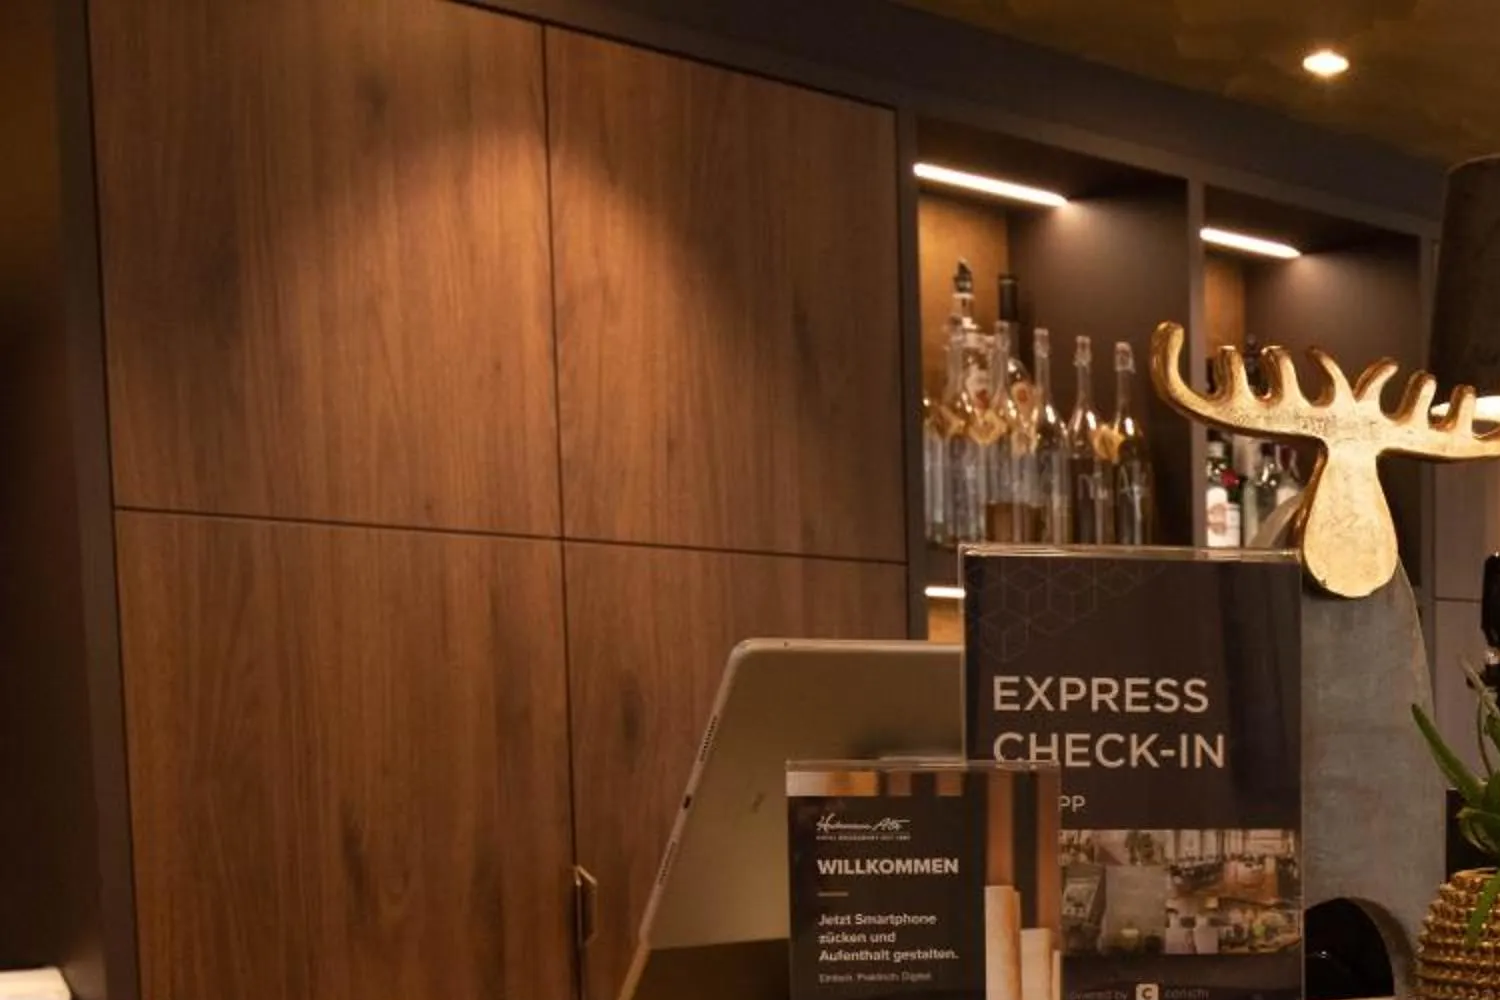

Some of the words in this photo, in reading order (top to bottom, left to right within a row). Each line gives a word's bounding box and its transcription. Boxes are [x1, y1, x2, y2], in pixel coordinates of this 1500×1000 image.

[993, 676, 1210, 713] EXPRESS
[993, 732, 1225, 769] CHECK-IN
[1060, 795, 1086, 812] PP
[817, 858, 959, 875] WILLKOMMEN
[818, 914, 851, 927] Jetzt
[855, 913, 937, 927] Smartphone
[818, 932, 867, 944] zücken
[870, 932, 896, 943] und
[818, 949, 891, 961] Aufenthalt
[893, 948, 959, 963] gestalten.
